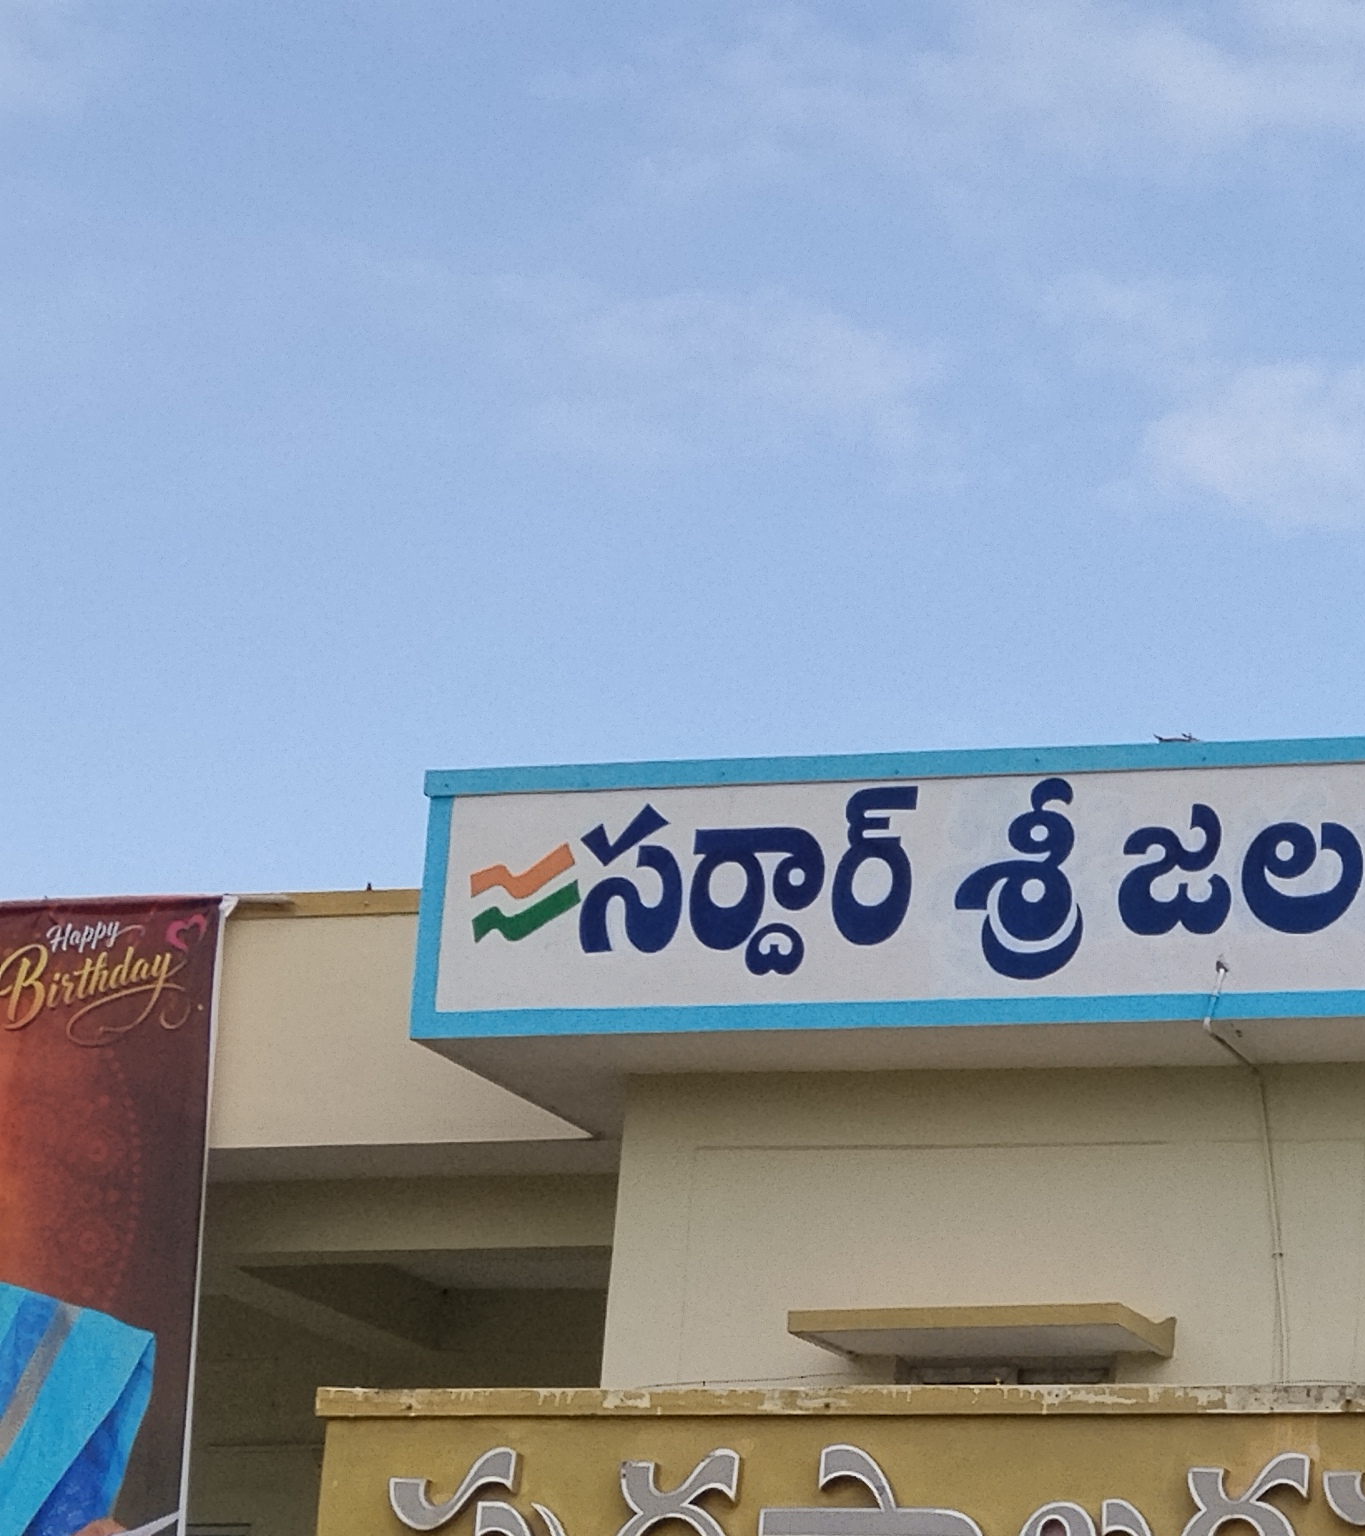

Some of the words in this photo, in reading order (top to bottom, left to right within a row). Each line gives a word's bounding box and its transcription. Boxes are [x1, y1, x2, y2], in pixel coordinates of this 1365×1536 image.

[579, 785, 918, 976] సర్దార్
[954, 776, 1082, 980] శ్రీ
[46, 920, 146, 954] Happy
[0, 943, 188, 1047] Birthday
